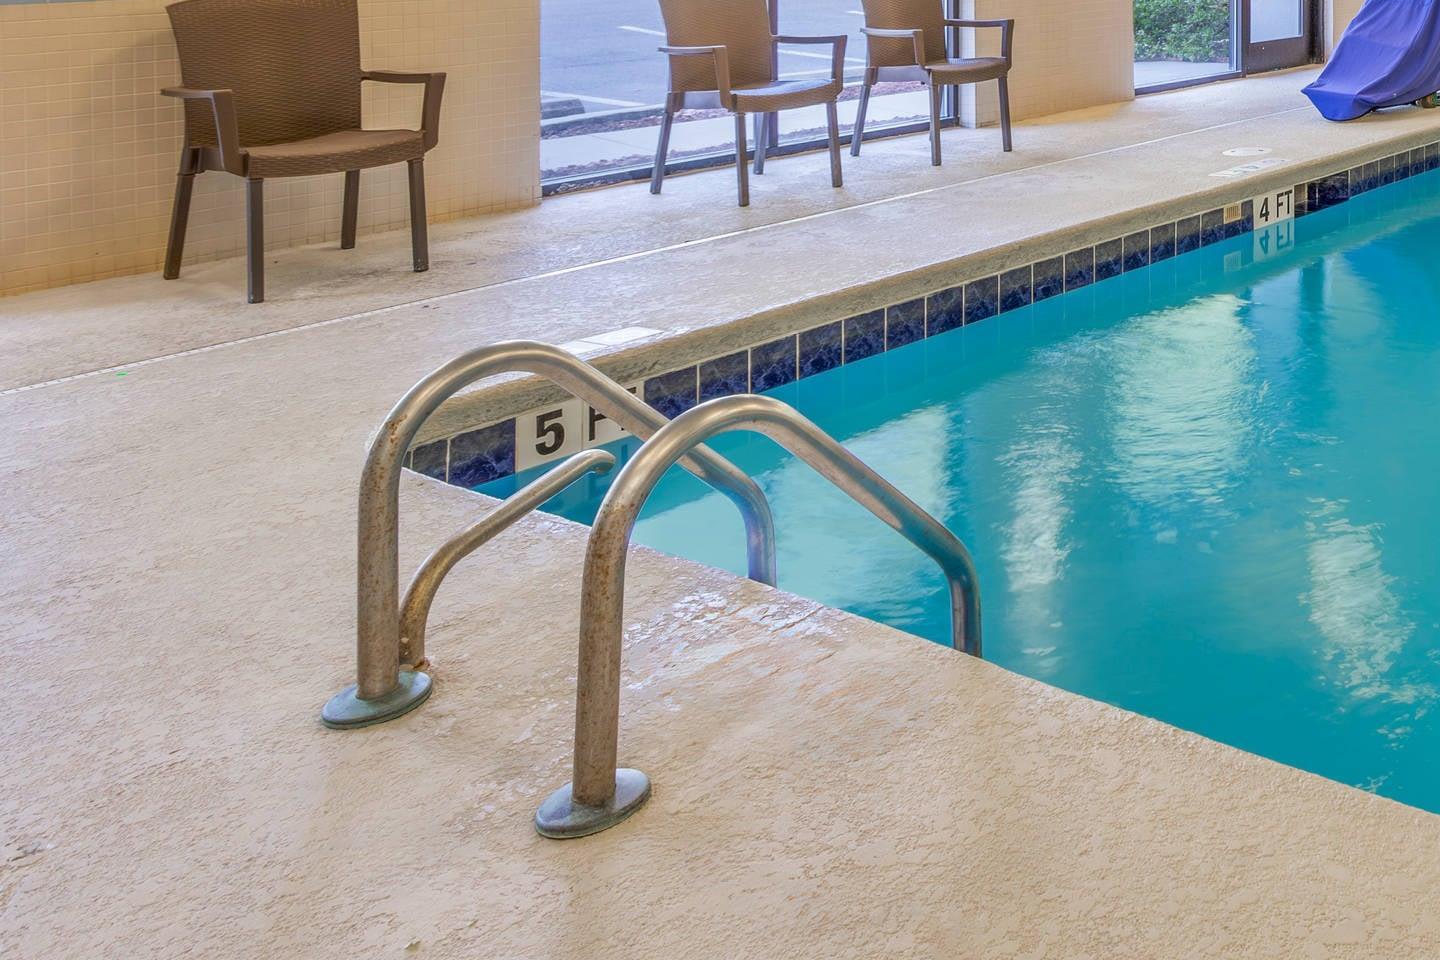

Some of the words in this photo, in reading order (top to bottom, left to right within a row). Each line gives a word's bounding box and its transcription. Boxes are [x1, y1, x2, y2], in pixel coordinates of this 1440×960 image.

[1260, 197, 1270, 222] 4
[1276, 190, 1292, 218] FT
[535, 408, 565, 456] 5
